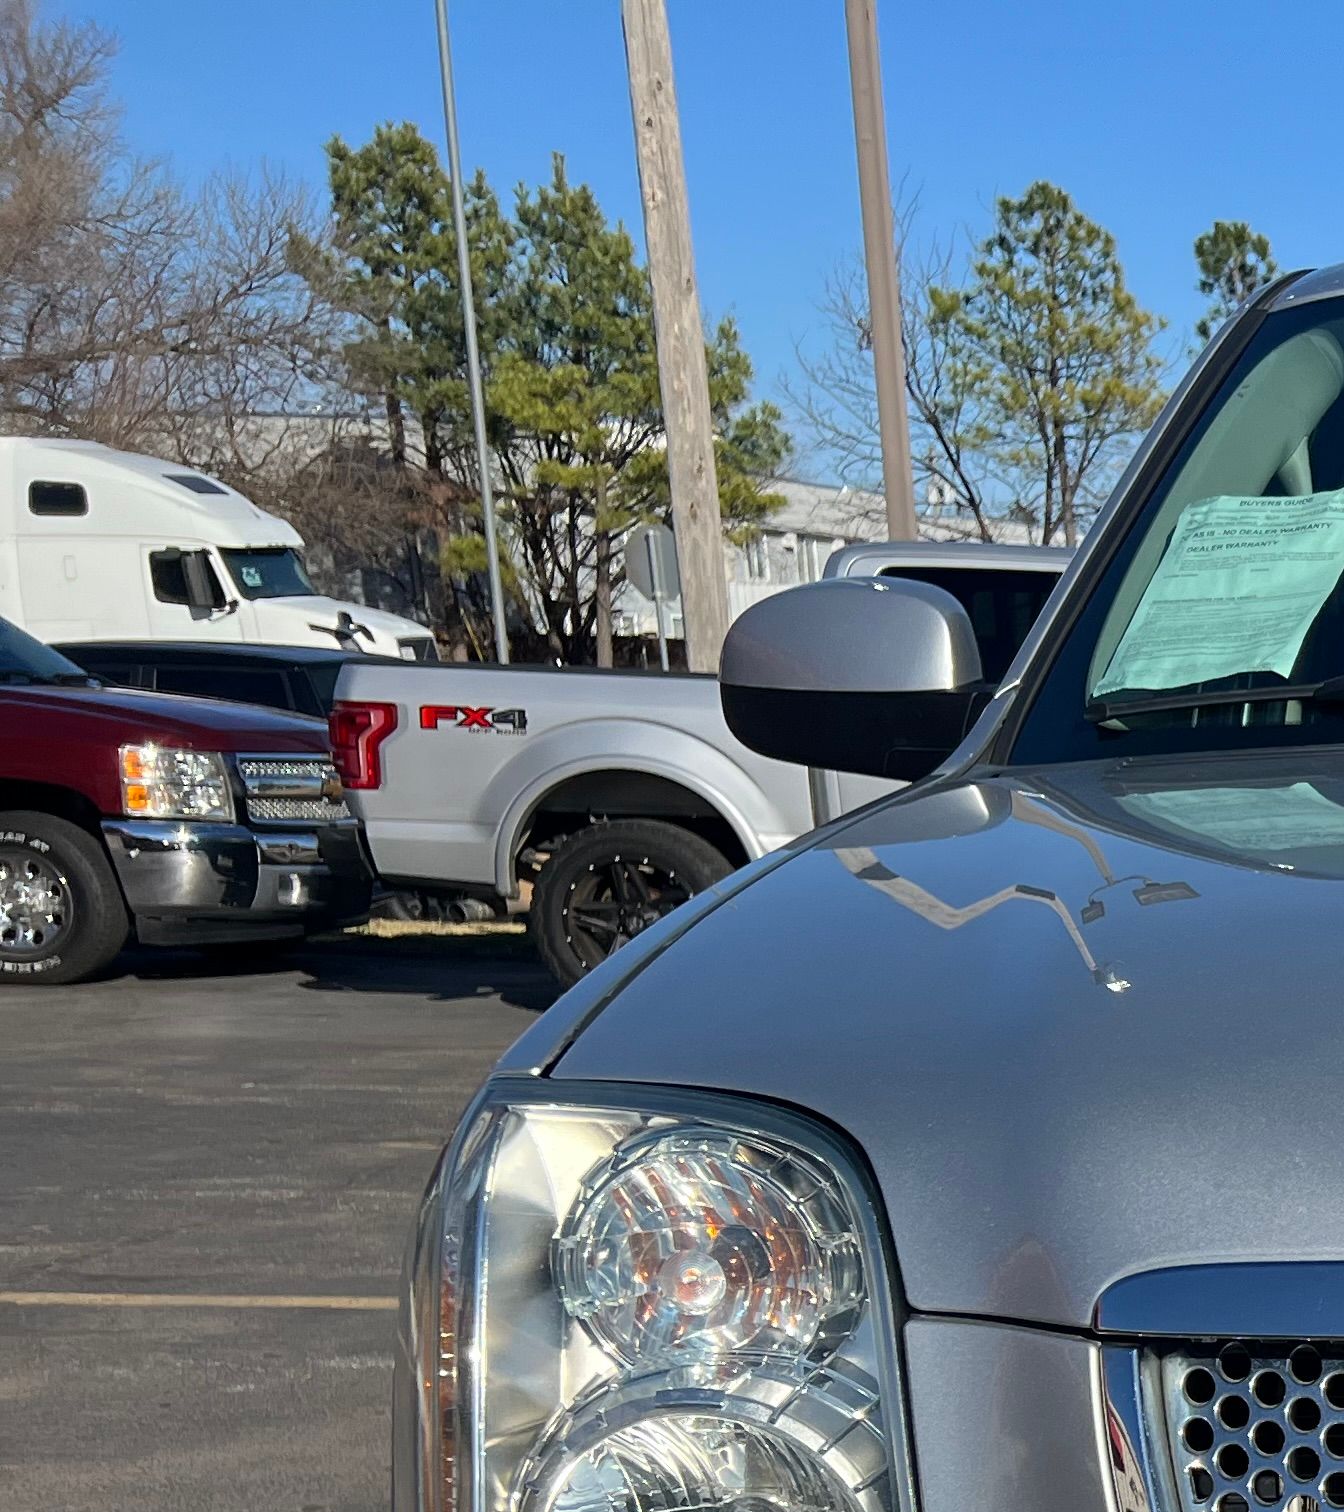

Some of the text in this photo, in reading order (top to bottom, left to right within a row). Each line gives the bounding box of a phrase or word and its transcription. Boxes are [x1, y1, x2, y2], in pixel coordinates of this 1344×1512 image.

[1284, 498, 1314, 506] GUIDE
[1280, 522, 1333, 534] WARRANTY
[1186, 540, 1280, 553] DEALER WARRANTY
[420, 705, 528, 730] FX4
